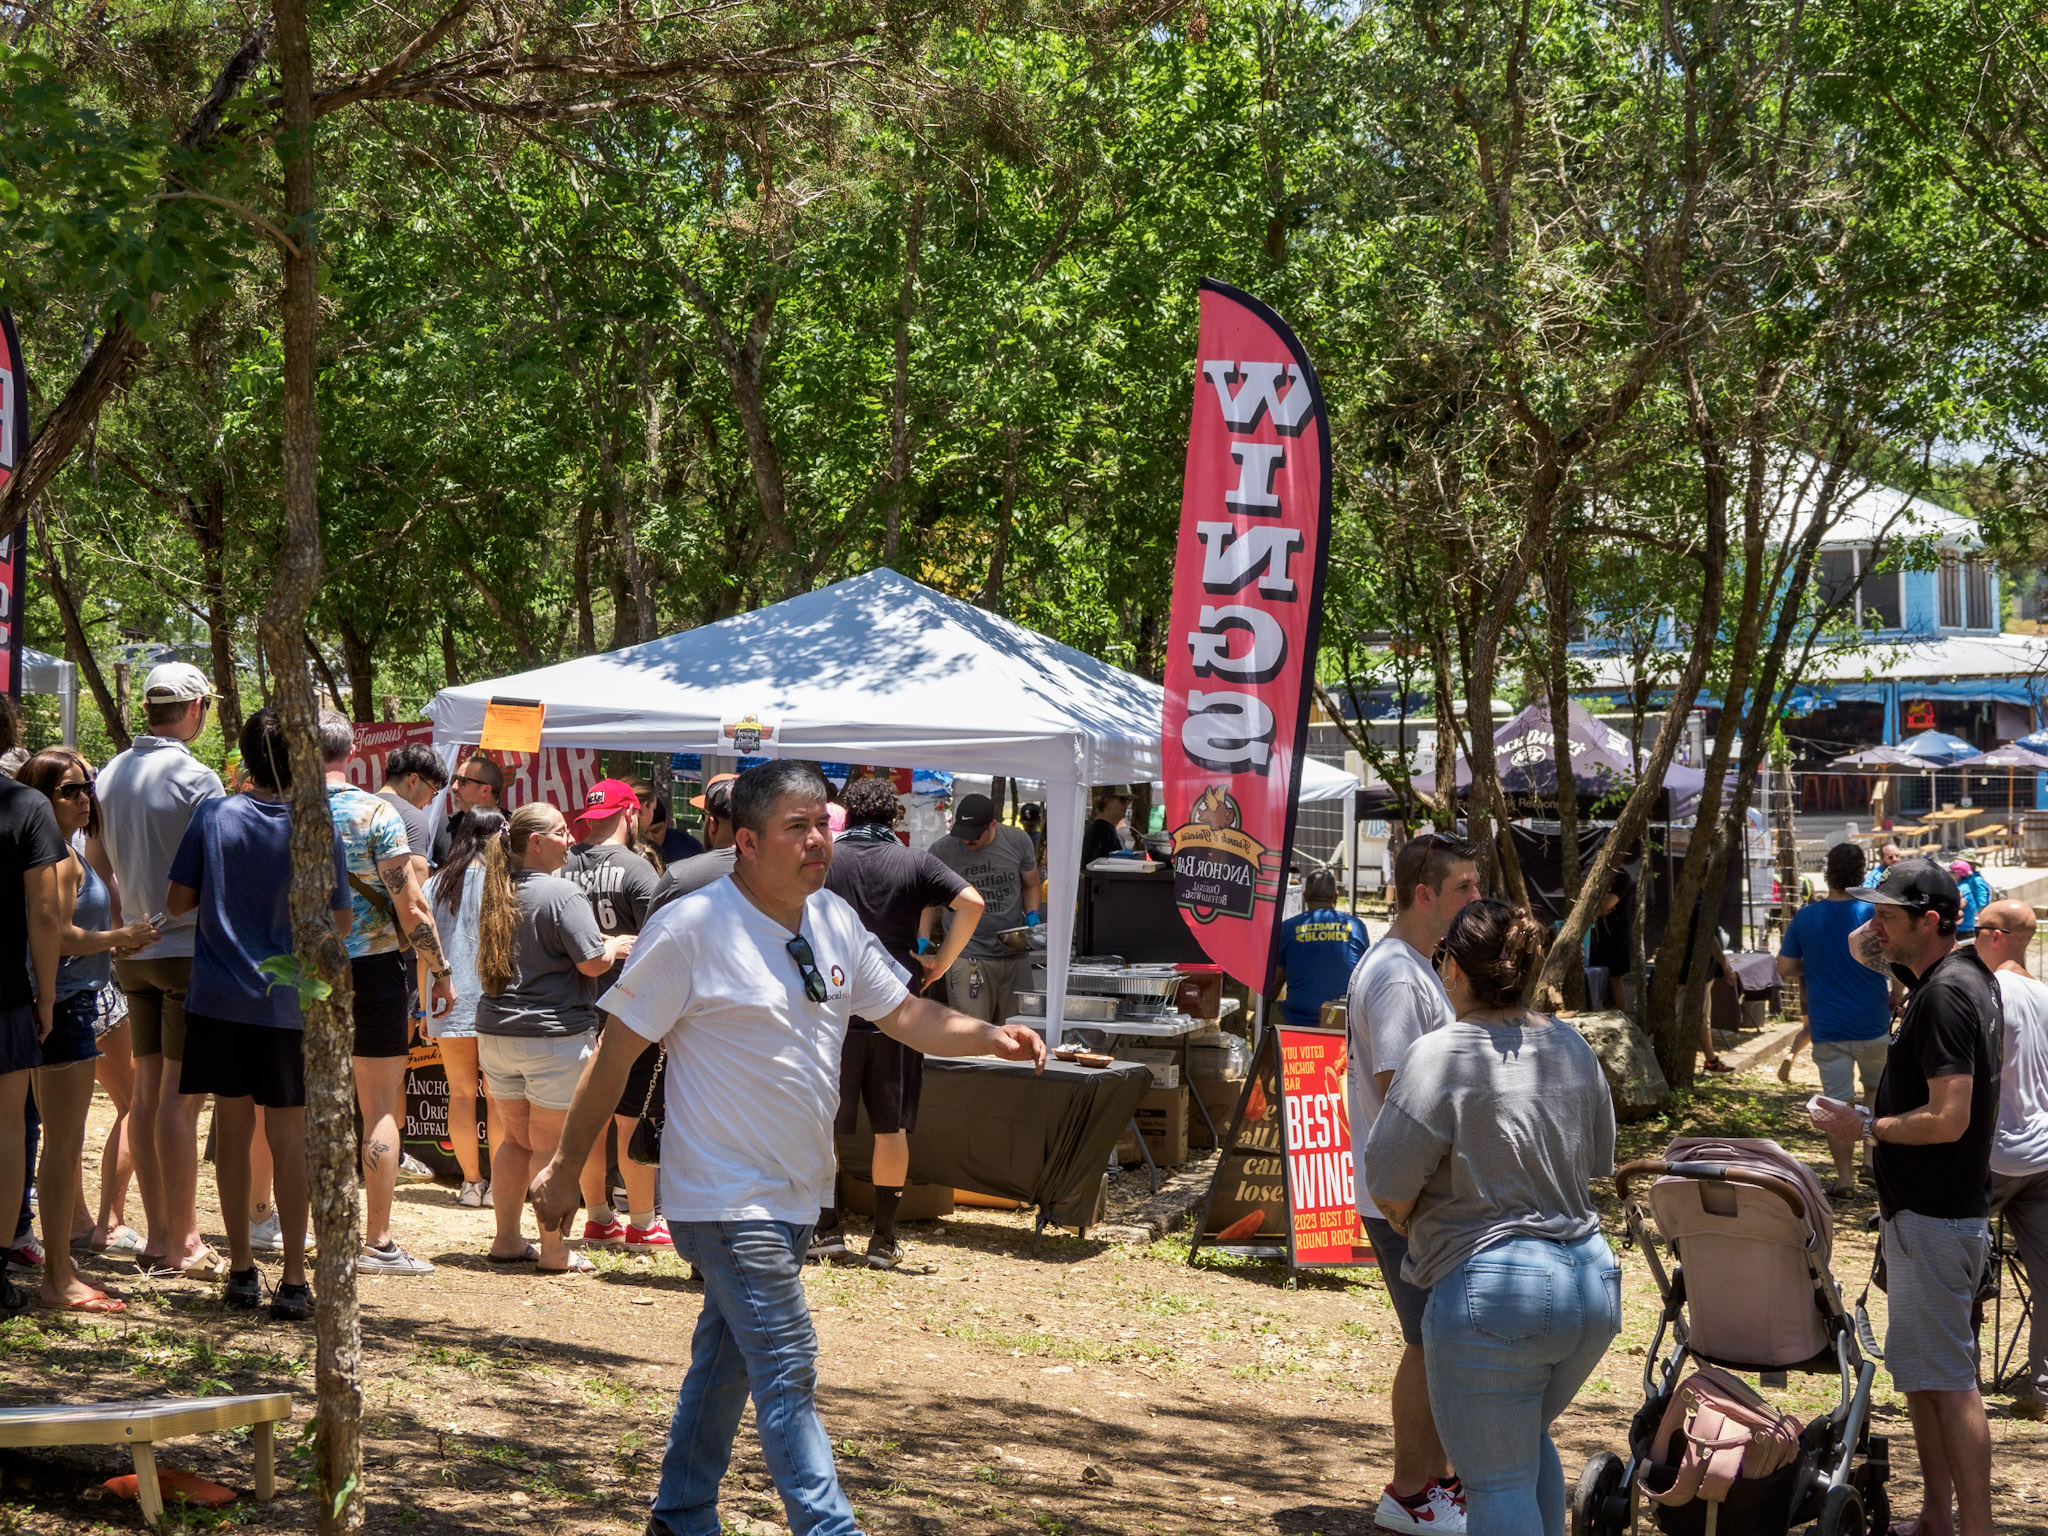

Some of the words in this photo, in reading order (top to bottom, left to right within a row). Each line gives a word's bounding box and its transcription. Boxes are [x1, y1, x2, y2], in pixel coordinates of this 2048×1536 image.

[355, 725, 403, 752] Famous
[965, 860, 995, 876] real.
[981, 888, 1012, 901] ings.
[1282, 1047, 1297, 1060] YOU
[1300, 1045, 1324, 1058] VOTED
[1283, 1061, 1315, 1075] ANCHOR
[406, 1071, 450, 1096] ANCHO
[1284, 1077, 1301, 1091] BAR
[406, 1115, 449, 1136] BUFFAL
[1285, 1093, 1341, 1150] BEST
[1294, 1213, 1317, 1230] 2023
[1320, 1211, 1343, 1228] BEST
[1345, 1210, 1356, 1225] OF
[1296, 1231, 1329, 1249] ROUND
[1331, 1228, 1354, 1246] ROCK
